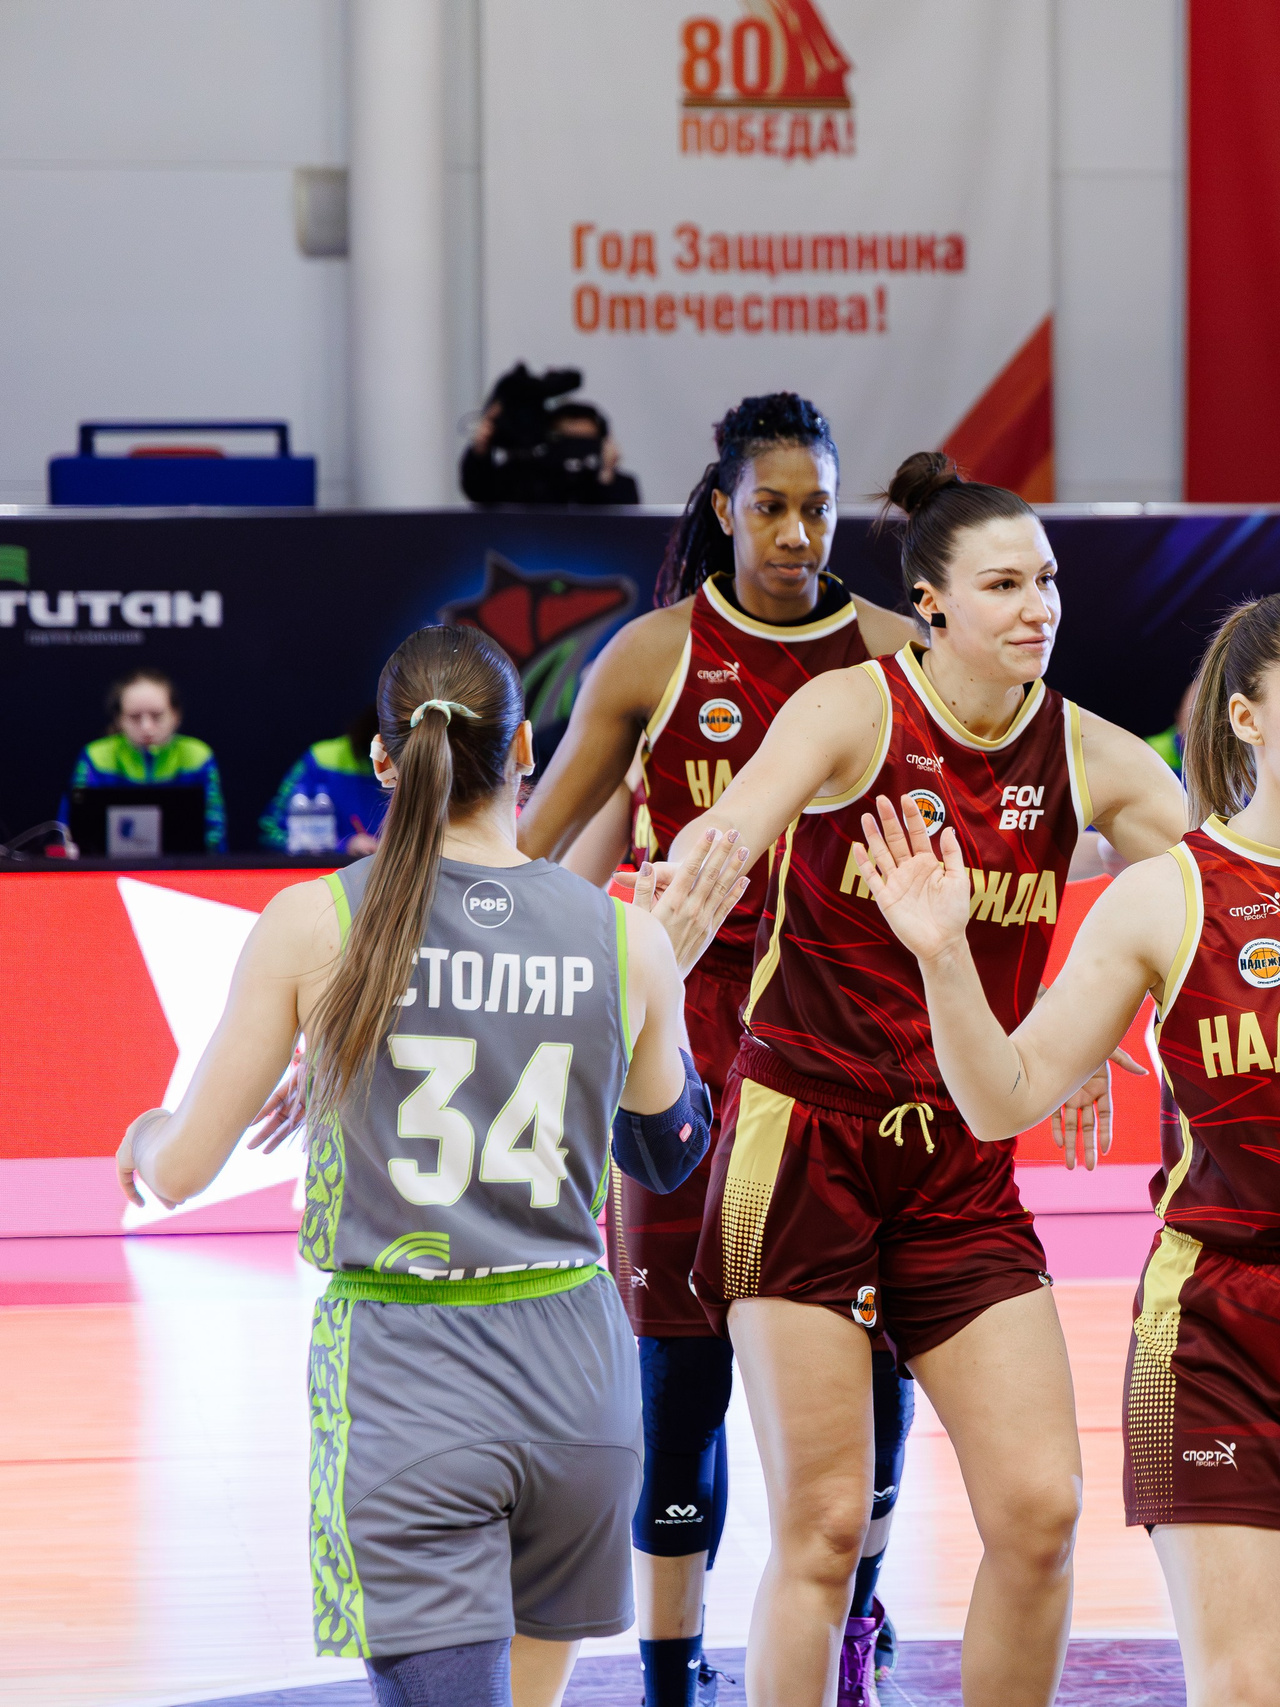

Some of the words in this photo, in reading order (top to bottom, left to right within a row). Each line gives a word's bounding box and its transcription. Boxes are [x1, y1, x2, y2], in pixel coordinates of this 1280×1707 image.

[679, 16, 774, 97] 80
[679, 114, 855, 160] ПОБЕДА!
[572, 222, 657, 277] Год
[674, 224, 967, 278] Защитника
[572, 284, 889, 335] Отечества!
[1000, 785, 1045, 807] FON
[998, 809, 1045, 831] BET
[469, 897, 508, 912] РФБ
[1229, 903, 1268, 917] СПОРТ
[388, 1034, 574, 1208] 34
[1183, 1451, 1222, 1461] СПОРТ
